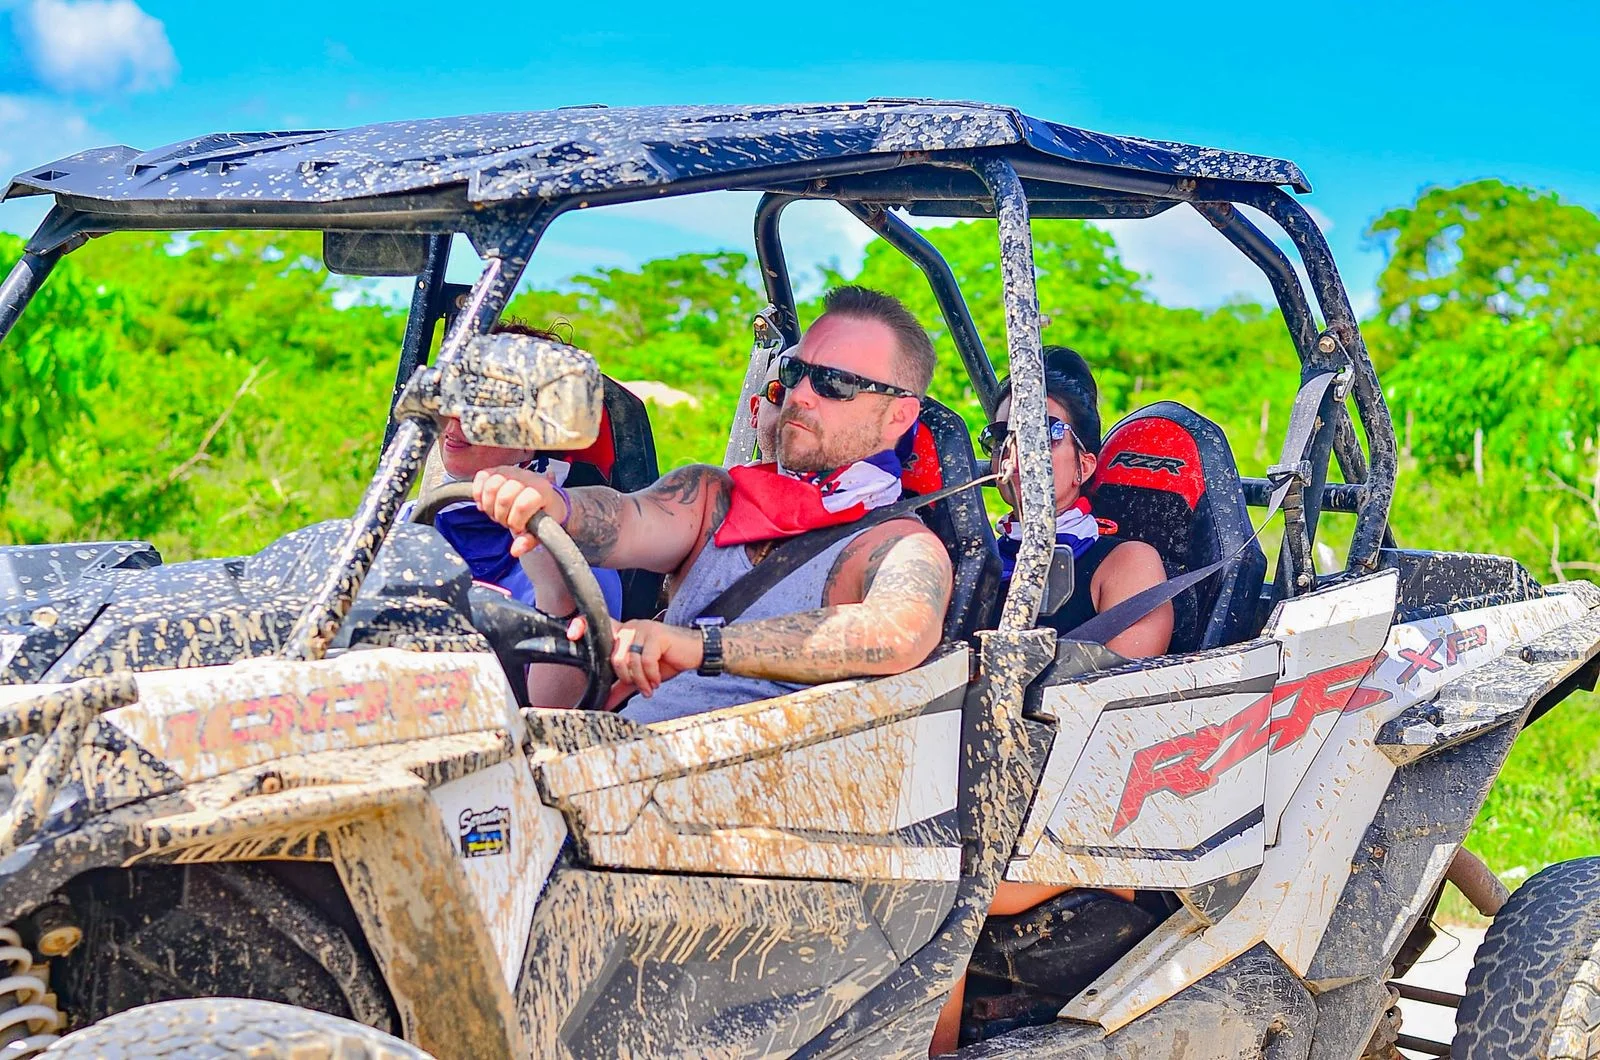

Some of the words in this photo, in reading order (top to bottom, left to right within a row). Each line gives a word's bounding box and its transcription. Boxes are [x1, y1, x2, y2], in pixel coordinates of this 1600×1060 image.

[1106, 451, 1186, 476] RZR
[1396, 624, 1488, 685] XP
[1110, 650, 1394, 837] RZR
